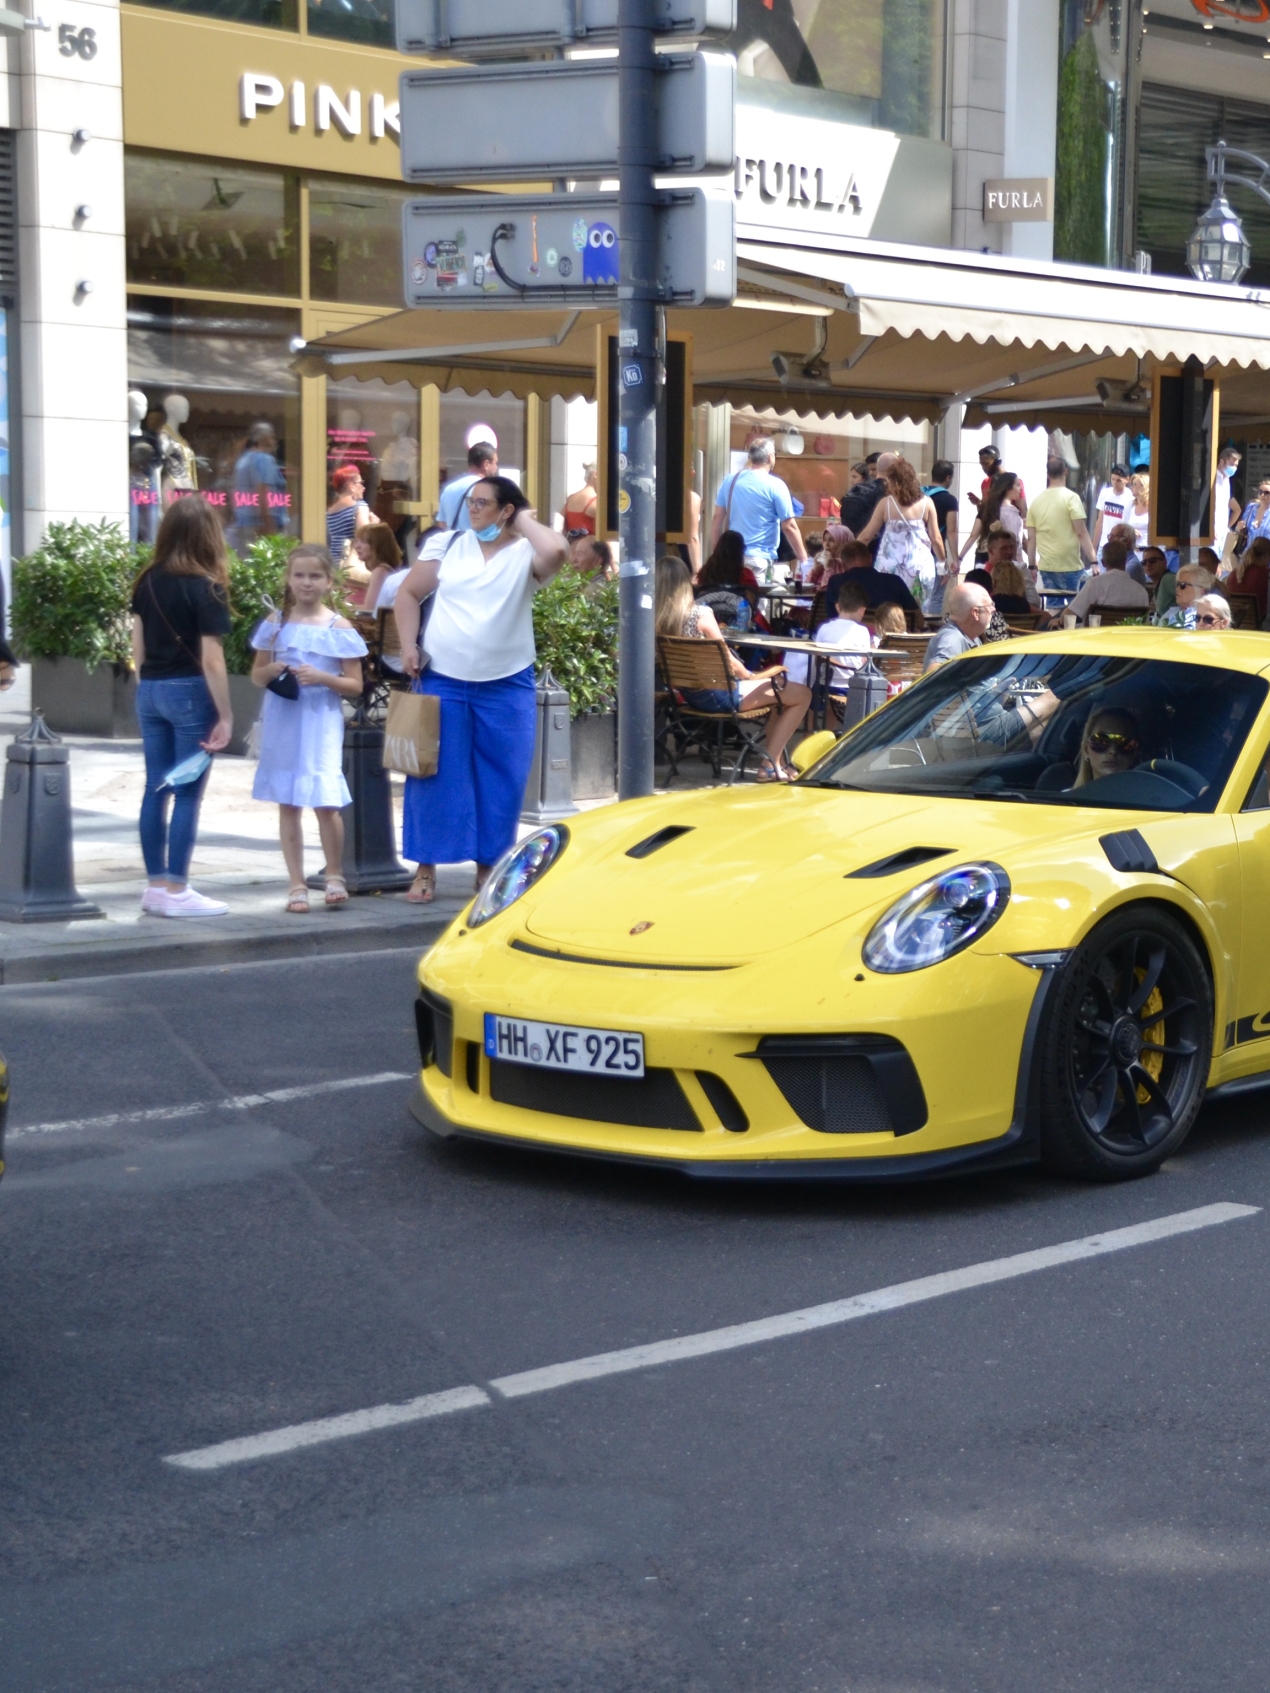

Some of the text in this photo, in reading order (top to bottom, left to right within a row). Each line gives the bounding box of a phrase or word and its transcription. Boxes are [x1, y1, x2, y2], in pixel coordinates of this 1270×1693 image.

[58, 23, 97, 60] 56
[239, 72, 400, 139] PINK
[735, 156, 863, 216] FURLA
[987, 191, 1043, 209] FURLA
[131, 489, 158, 505] SALE
[234, 491, 260, 507] SALE
[266, 492, 292, 508] SALE
[488, 1040, 494, 1049] D
[497, 1020, 642, 1070] HH XF 925
